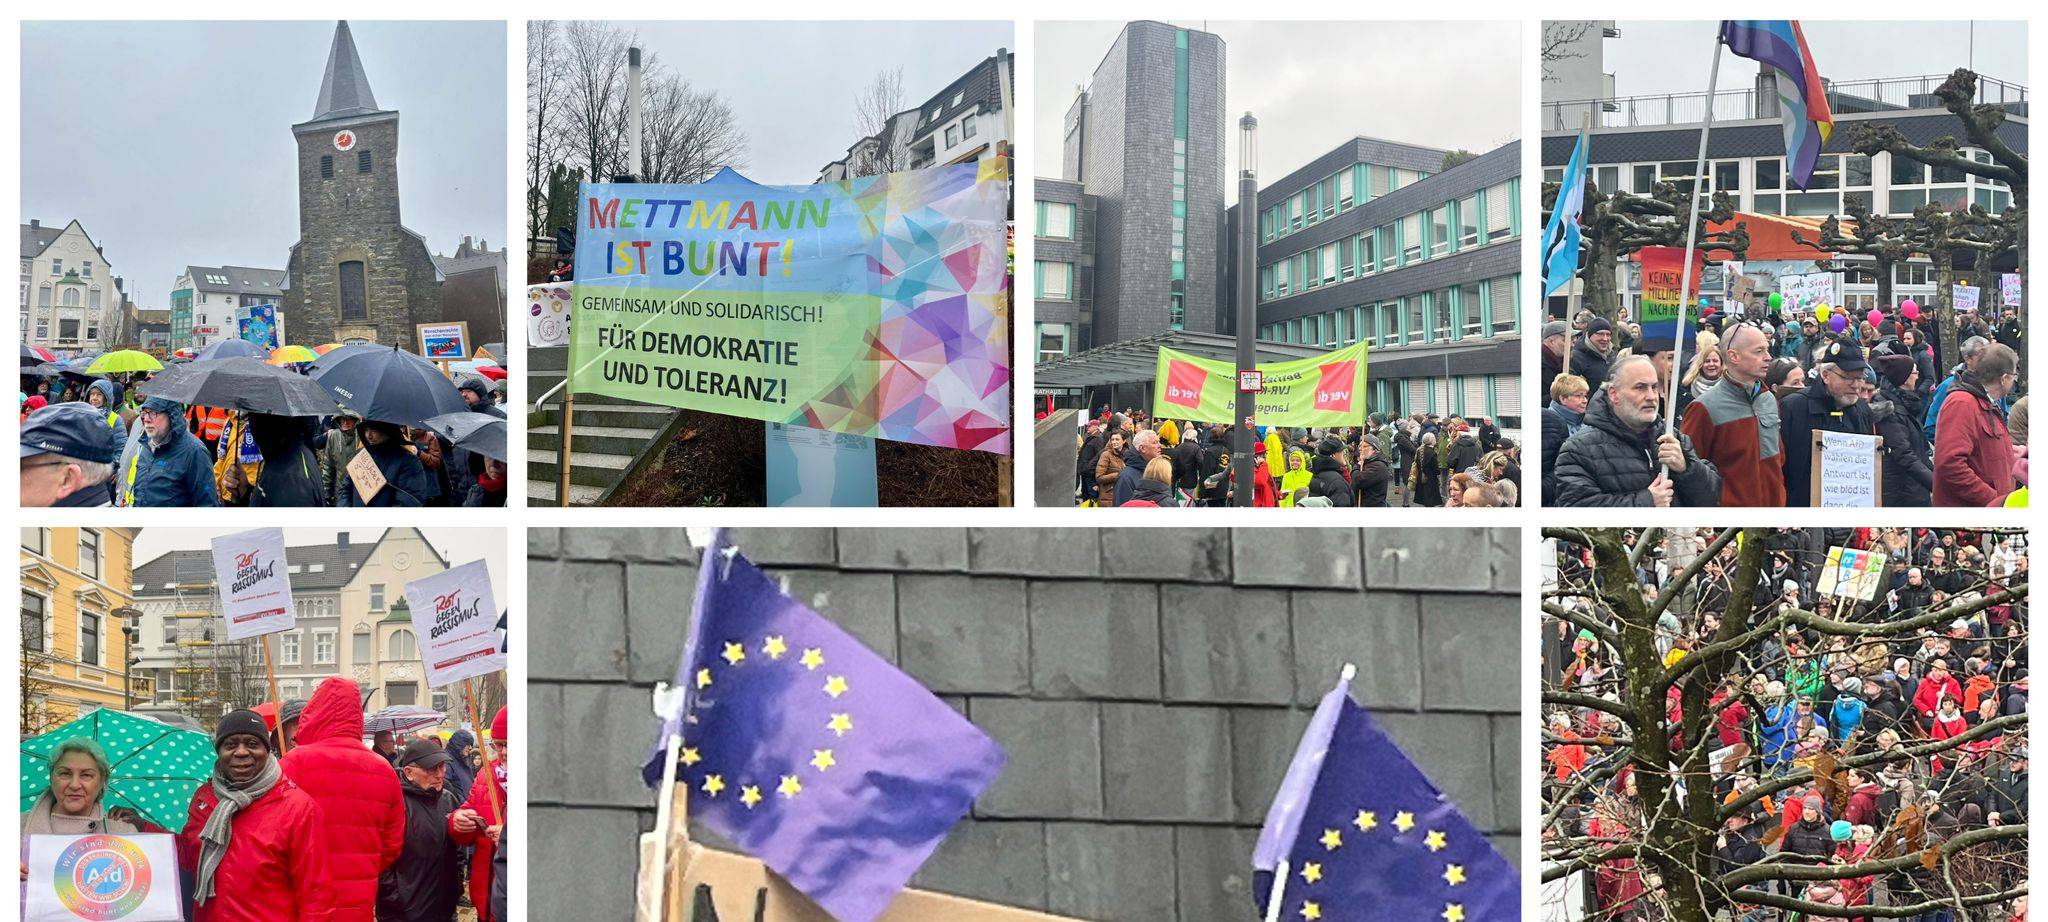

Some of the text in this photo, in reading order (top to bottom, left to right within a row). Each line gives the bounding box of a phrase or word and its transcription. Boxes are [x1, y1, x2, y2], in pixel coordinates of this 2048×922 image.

[589, 198, 831, 230] METTMANN
[606, 239, 794, 278] IST BUNT!
[1648, 271, 1682, 285] KEINEN
[582, 296, 823, 323] GEMEINSAM UND SOLIDARISCH!
[1648, 303, 1668, 316] NACH
[598, 323, 636, 351] FÜR
[642, 331, 799, 366] DEMOKRATIE
[603, 360, 788, 404] UND TOLERANZ!
[1824, 436, 1865, 448] Wenn AfD
[1855, 455, 1867, 464] die
[1824, 468, 1858, 479] Antwort
[1824, 484, 1870, 495] wie blöd ist
[231, 559, 275, 595] RASSISMUS
[236, 557, 259, 580] GEGEN
[430, 597, 480, 640] RASSISMUS
[435, 597, 460, 624] GEGEN
[62, 849, 77, 867] Wir
[80, 840, 104, 851] sind
